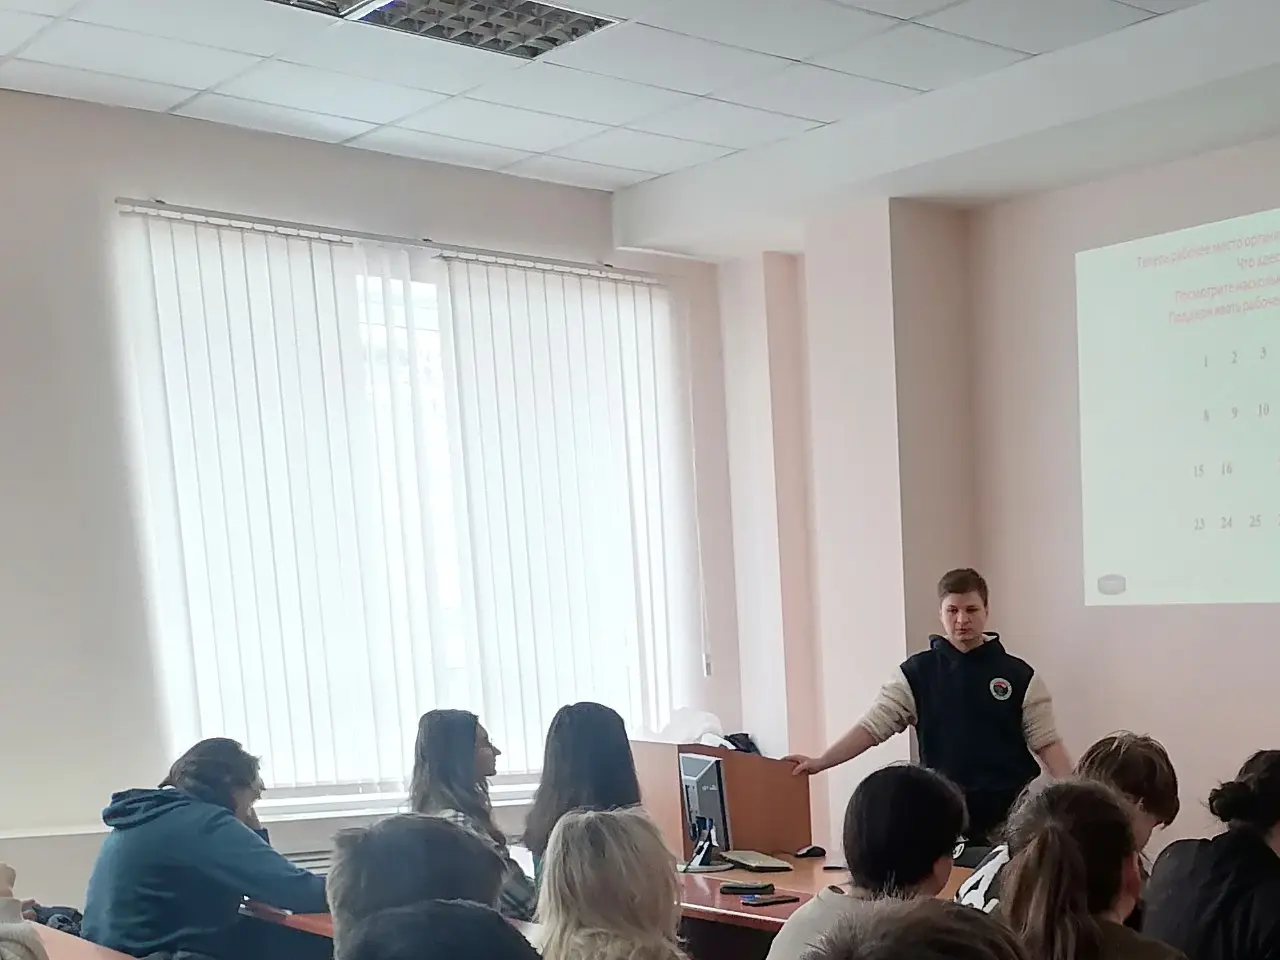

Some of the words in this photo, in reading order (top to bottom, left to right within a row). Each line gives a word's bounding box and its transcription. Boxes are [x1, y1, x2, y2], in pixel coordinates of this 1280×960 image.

[1212, 238, 1243, 253] место
[1237, 256, 1256, 269] Что
[1175, 282, 1237, 301] Посмотрите
[1258, 403, 1270, 417] 10
[1193, 464, 1204, 478] 15
[1221, 462, 1233, 476] 16
[1194, 518, 1205, 530] 23
[1220, 516, 1233, 529] 24
[1249, 514, 1262, 527] 25
